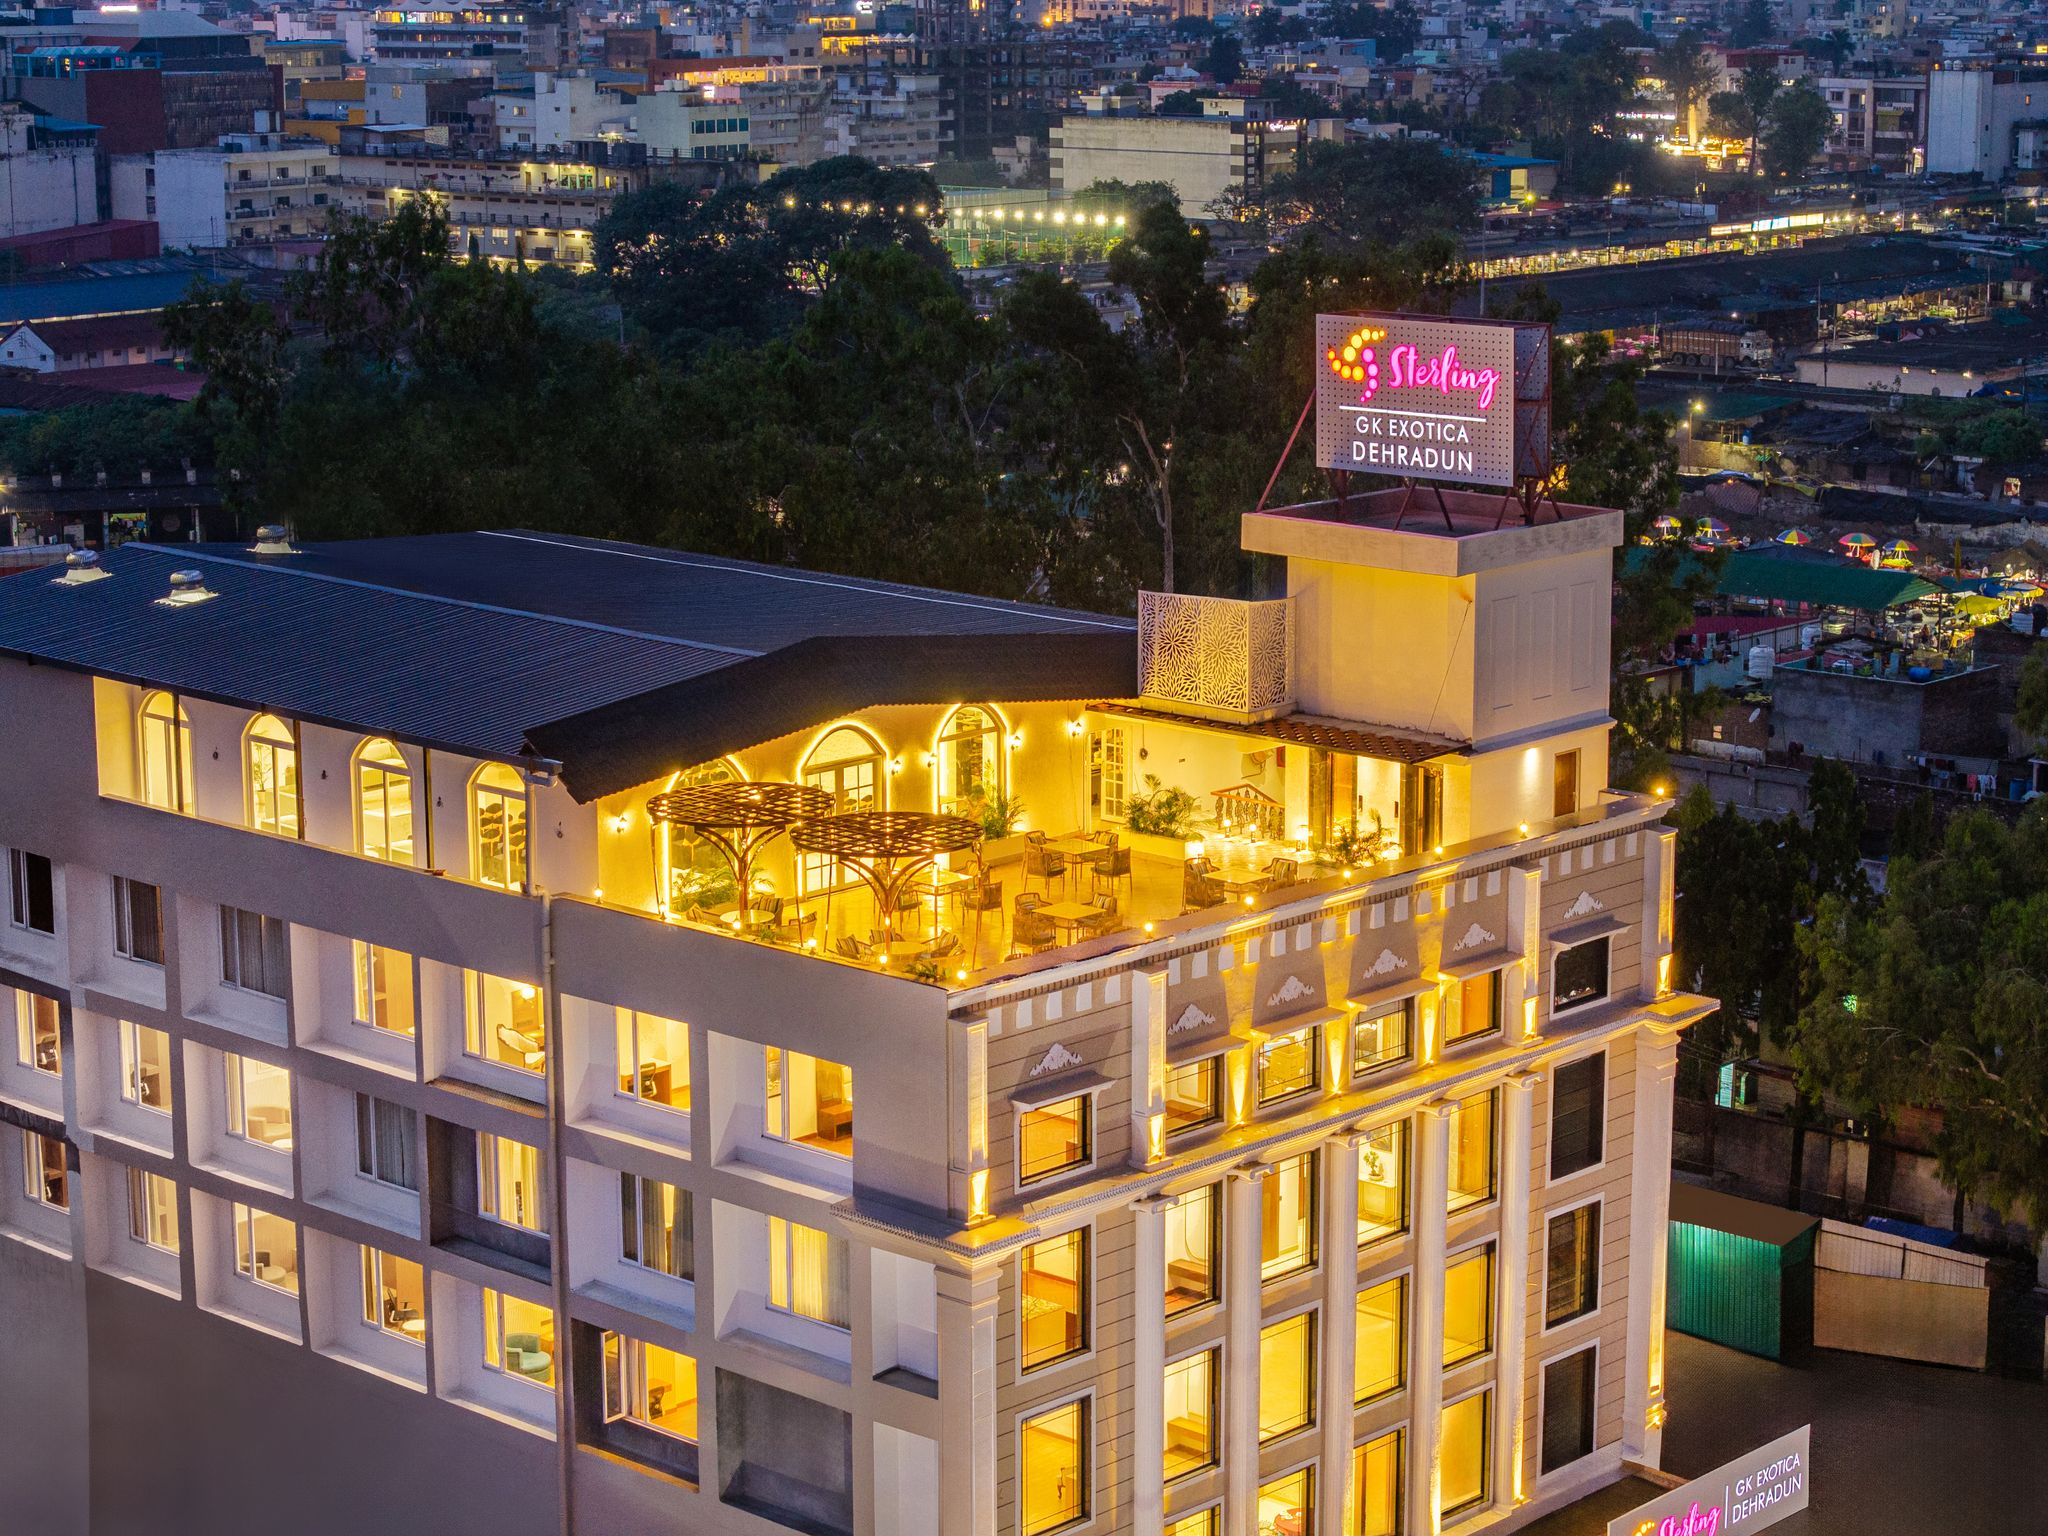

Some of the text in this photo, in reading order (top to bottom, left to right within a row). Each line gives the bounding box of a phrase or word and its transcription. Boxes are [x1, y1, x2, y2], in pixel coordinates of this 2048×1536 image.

[1389, 344, 1500, 409] Sterling
[1355, 416, 1469, 443] GK EXOTICA
[1352, 441, 1473, 472] DEHRADUN
[1735, 1452, 1800, 1497] GK EXOTICA
[1732, 1473, 1801, 1524] DEHRADUN
